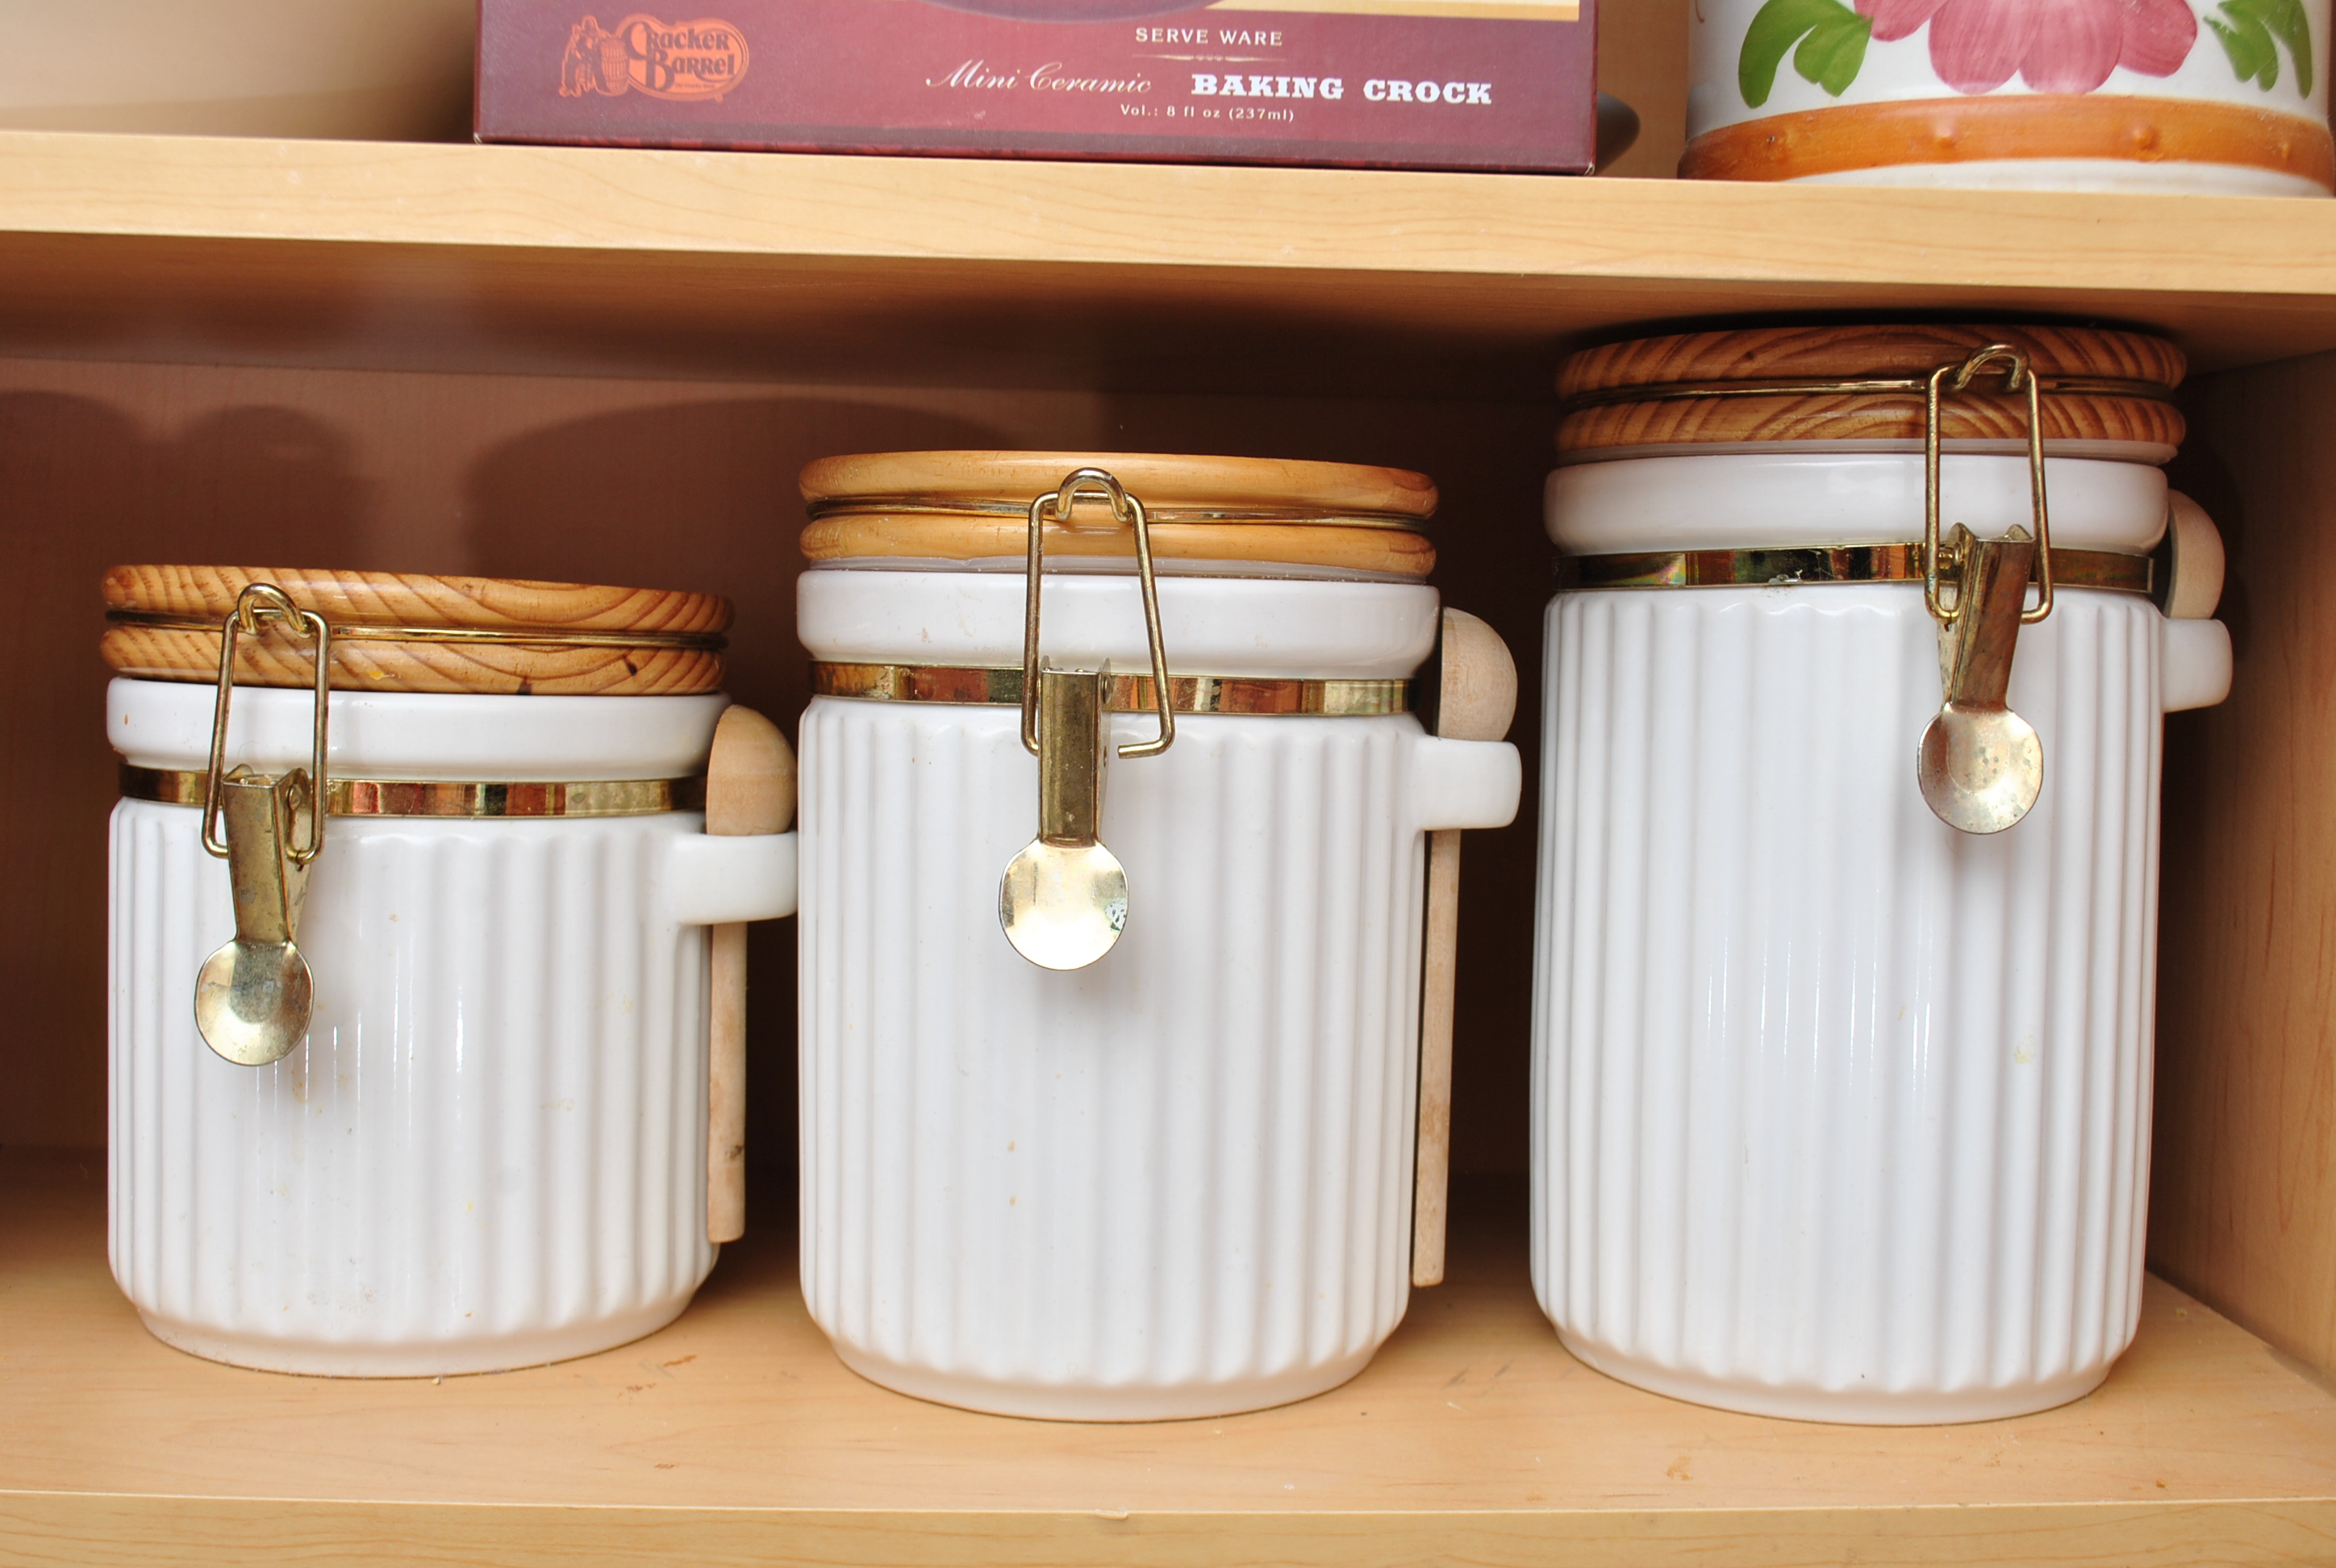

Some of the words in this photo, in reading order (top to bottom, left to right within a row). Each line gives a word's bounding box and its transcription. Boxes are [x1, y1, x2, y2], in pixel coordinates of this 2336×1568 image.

[1135, 27, 1208, 44] SERVE
[1219, 29, 1283, 47] WARE
[925, 59, 1021, 89] Mini
[1025, 62, 1152, 94] Ceramic
[1191, 73, 1345, 100] BAKING
[1362, 78, 1492, 105] CROCK
[1120, 103, 1158, 117] Vol.:
[1166, 105, 1176, 118] 8
[1183, 106, 1195, 118] fl
[1202, 109, 1220, 119] oz
[1228, 107, 1295, 123] (237ml)
